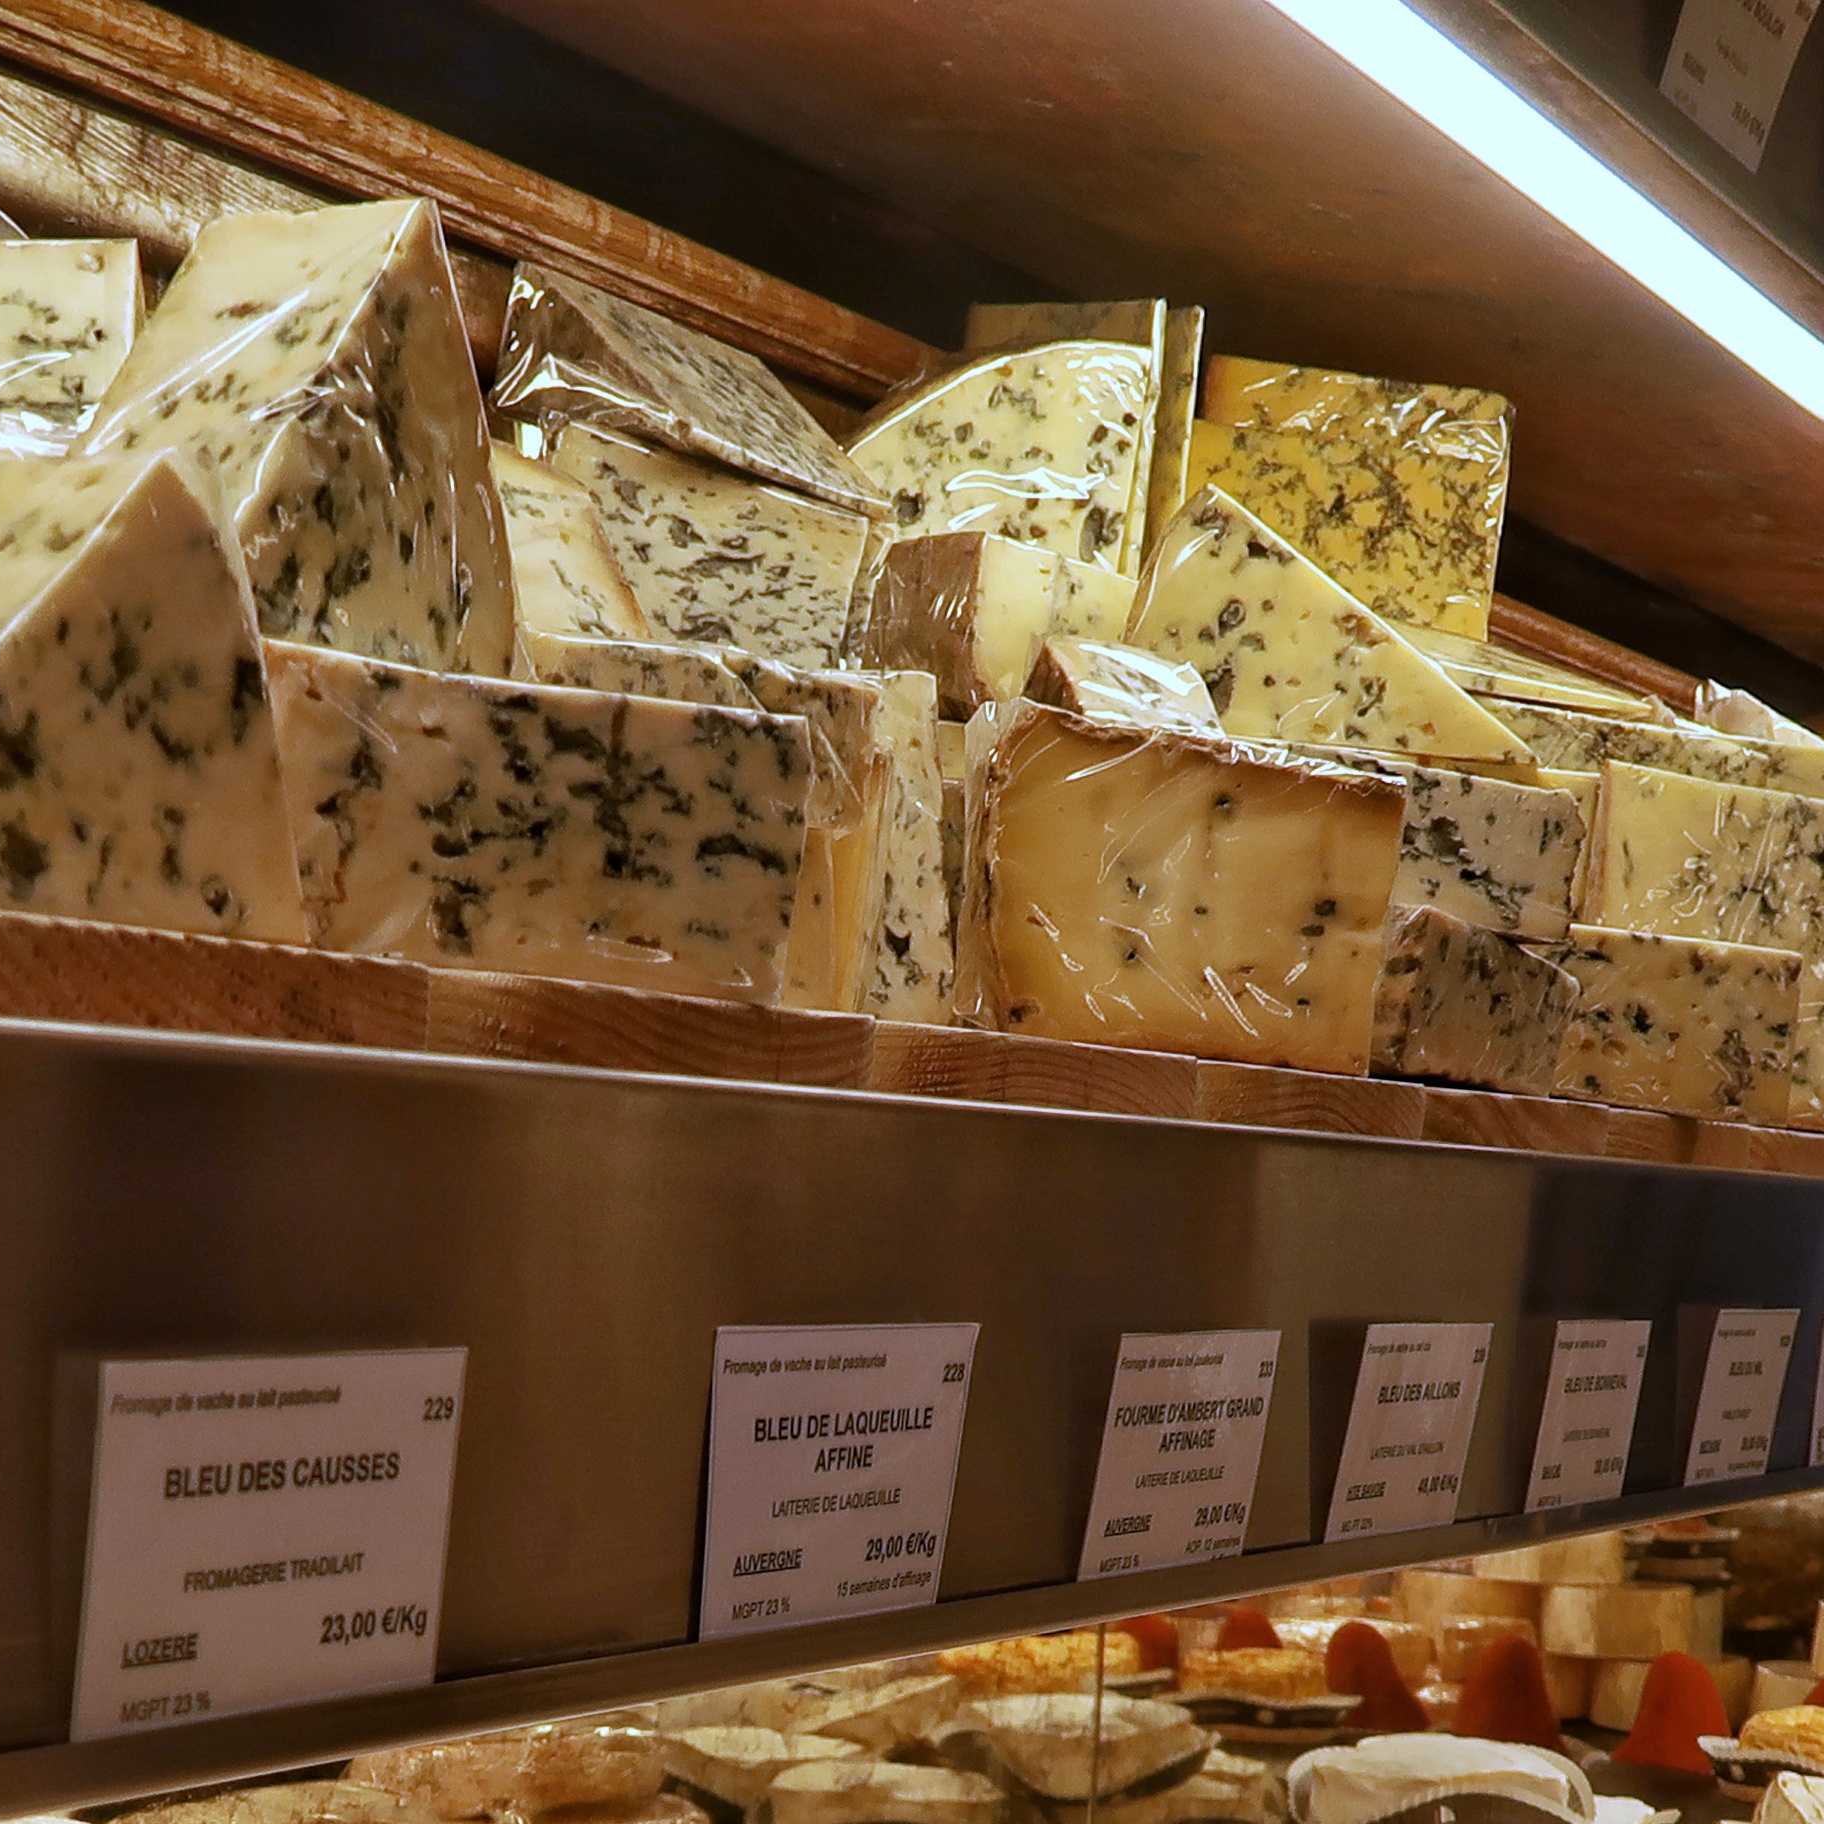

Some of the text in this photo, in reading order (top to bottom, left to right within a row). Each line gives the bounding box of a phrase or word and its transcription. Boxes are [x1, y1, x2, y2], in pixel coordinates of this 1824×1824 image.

[723, 1358, 767, 1377] Fromage
[770, 1357, 782, 1373] de
[784, 1355, 812, 1371] vache
[813, 1357, 826, 1371] au
[827, 1354, 841, 1370] lait
[942, 1363, 965, 1383] 228
[1378, 1385, 1401, 1404] BLEU
[1403, 1383, 1423, 1402] DES
[423, 1397, 455, 1422] 229
[1114, 1397, 1264, 1428] FOURME D'AMBERT GRAND
[754, 1406, 934, 1443] BLEU DE LAQUEUILLE
[1159, 1429, 1216, 1453] AFFINAGE
[814, 1445, 874, 1473] AFFINE
[164, 1452, 401, 1500] BLEU DES CAUSSES
[771, 1497, 820, 1519] LAITERIE
[823, 1496, 837, 1514] DE
[1103, 1514, 1153, 1537] AUVERGNE
[865, 1530, 937, 1563] 29,00 €/Kg
[183, 1552, 365, 1594] FROMAGERIE TRADILAIT
[733, 1547, 804, 1577] AUVERGNE
[836, 1583, 847, 1598] 15
[849, 1576, 890, 1597] semaines
[732, 1600, 765, 1622] MGPT
[320, 1604, 427, 1646] 23,00 €/Kg
[120, 1633, 198, 1670] LOZERE
